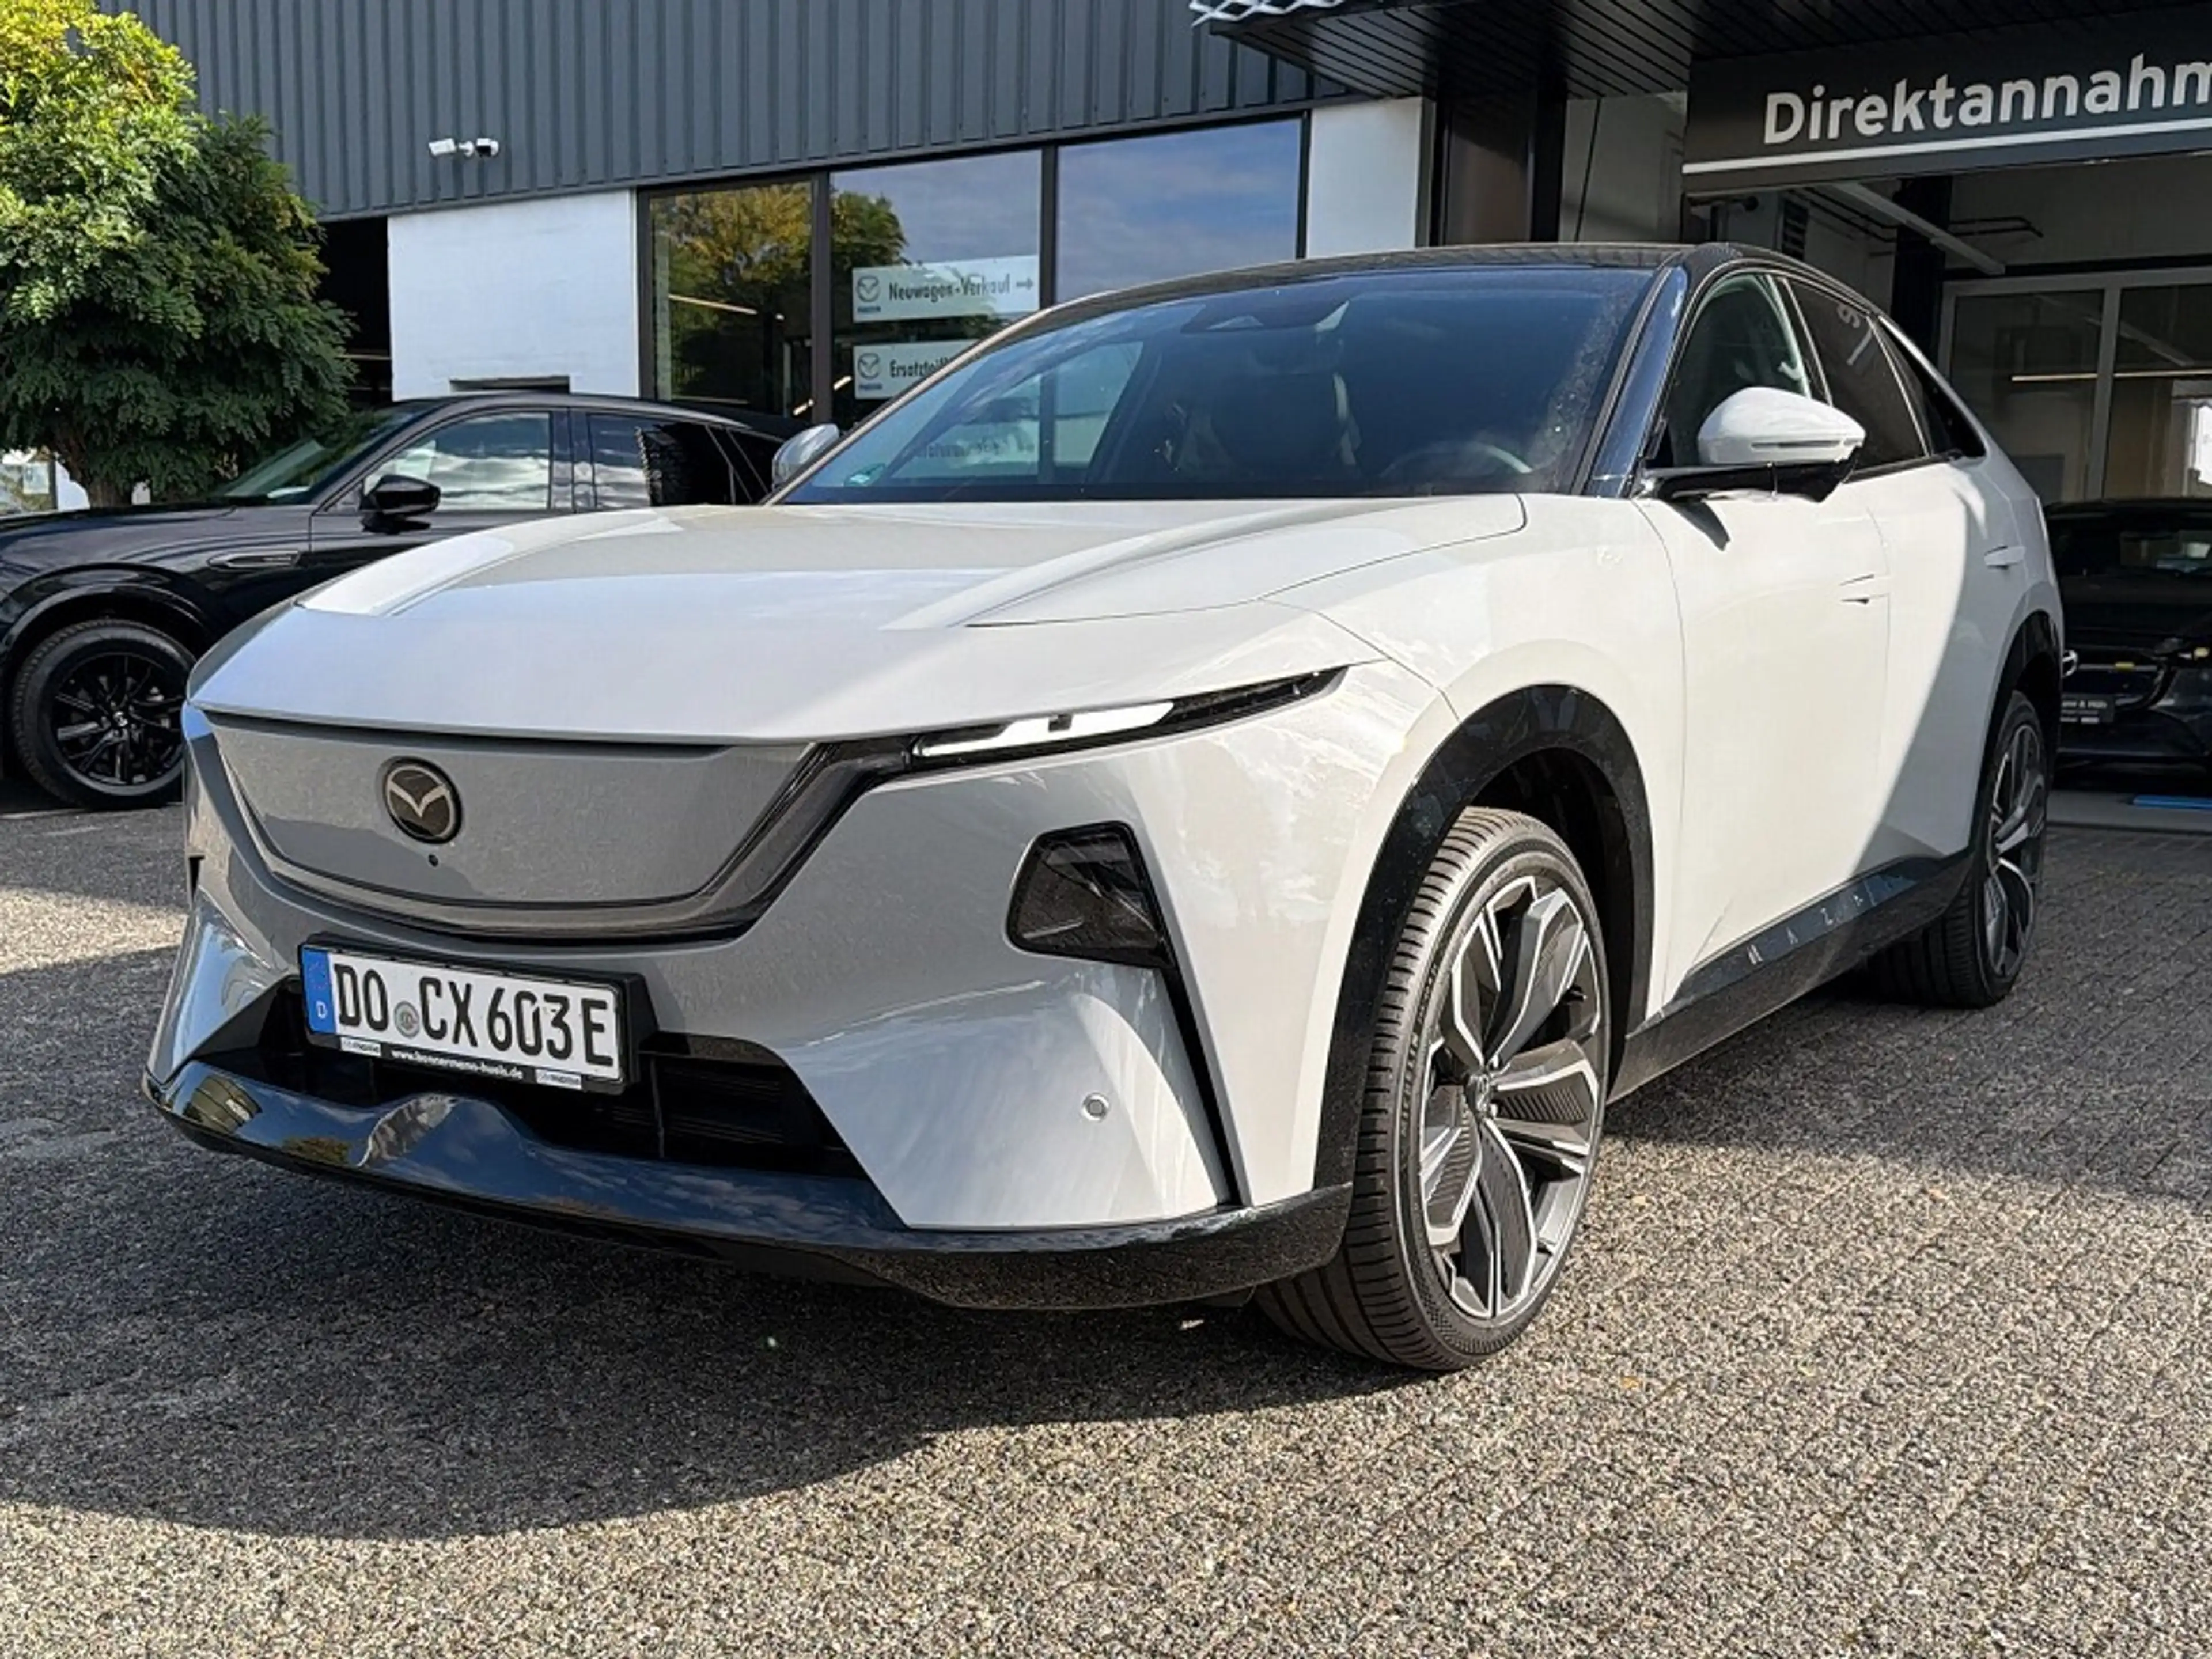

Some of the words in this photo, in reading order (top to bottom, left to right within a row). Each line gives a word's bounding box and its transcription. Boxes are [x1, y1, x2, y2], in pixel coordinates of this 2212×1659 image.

[1763, 53, 2212, 146] Direktannahm
[889, 274, 1010, 302] Neuwagen-Verkauf
[334, 963, 389, 1031] DO
[419, 976, 478, 1047] CX
